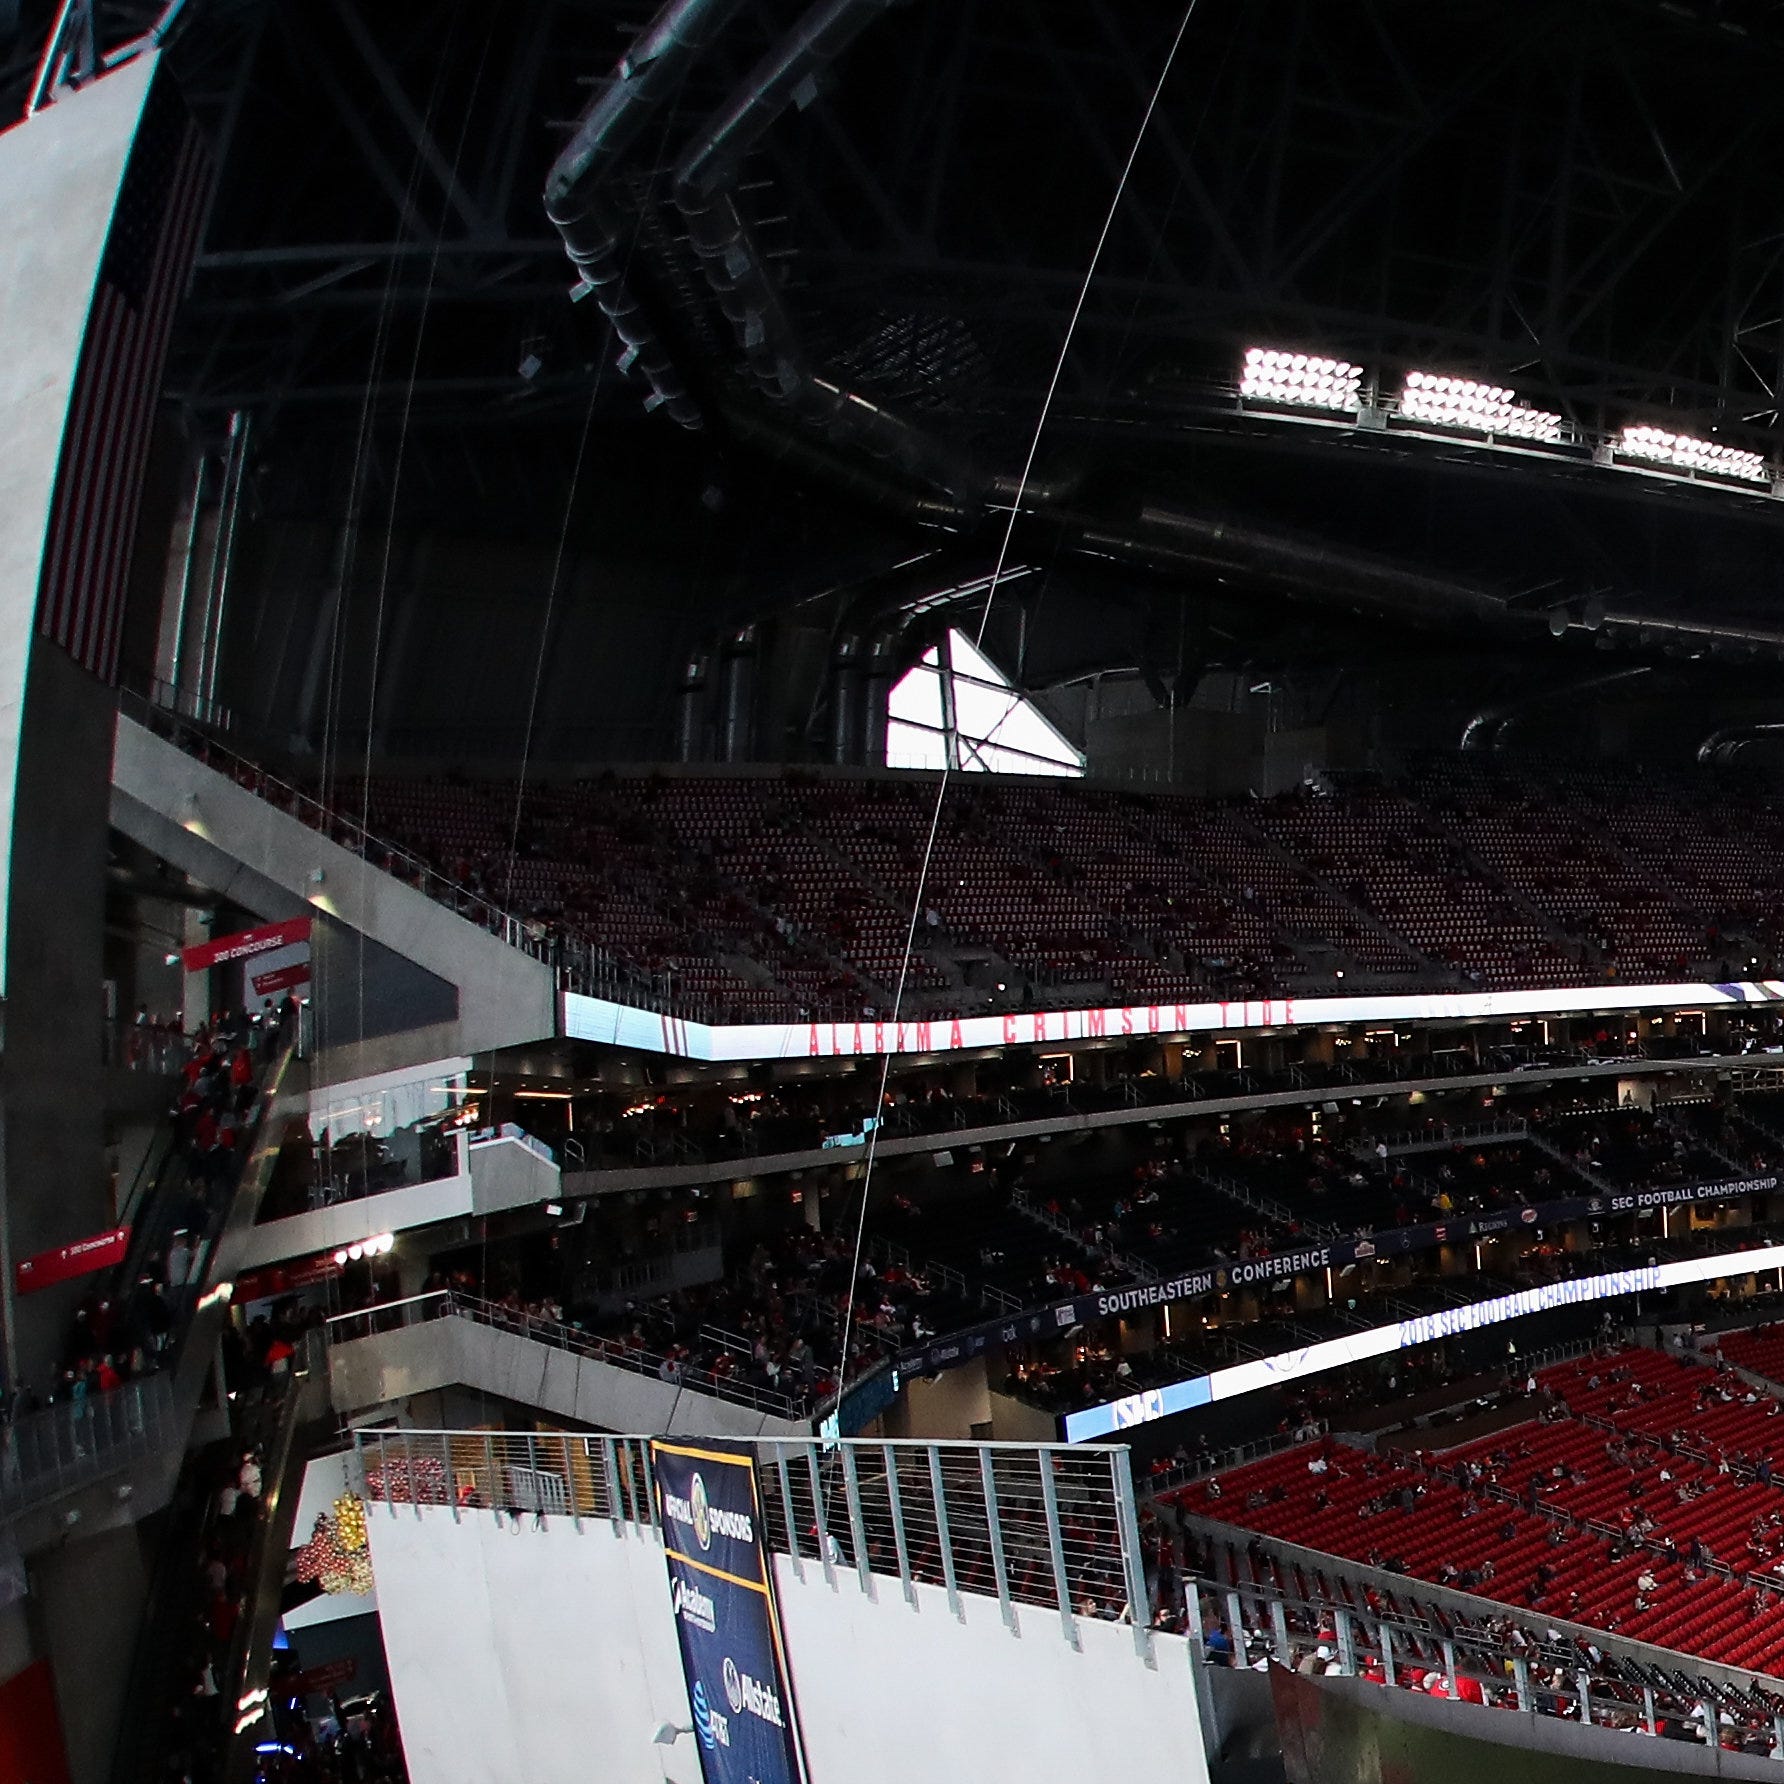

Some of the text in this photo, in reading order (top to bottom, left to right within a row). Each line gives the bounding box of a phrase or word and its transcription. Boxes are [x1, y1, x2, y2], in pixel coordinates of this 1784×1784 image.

[230, 935, 285, 959] CONCOURSE
[809, 998, 1295, 1057] ALABAMA CRIMSON TIDE
[1611, 1176, 1778, 1211] SEC FOOTBALL CHAMPIONSHIP
[1098, 1248, 1331, 1316] SOUTHEASTERN CONFERENCE
[1399, 1265, 1662, 1347] 2018 SEC FOOTBALL CHAMPIONSHIP
[665, 1493, 753, 1543] OFFICIAL SPONSORS
